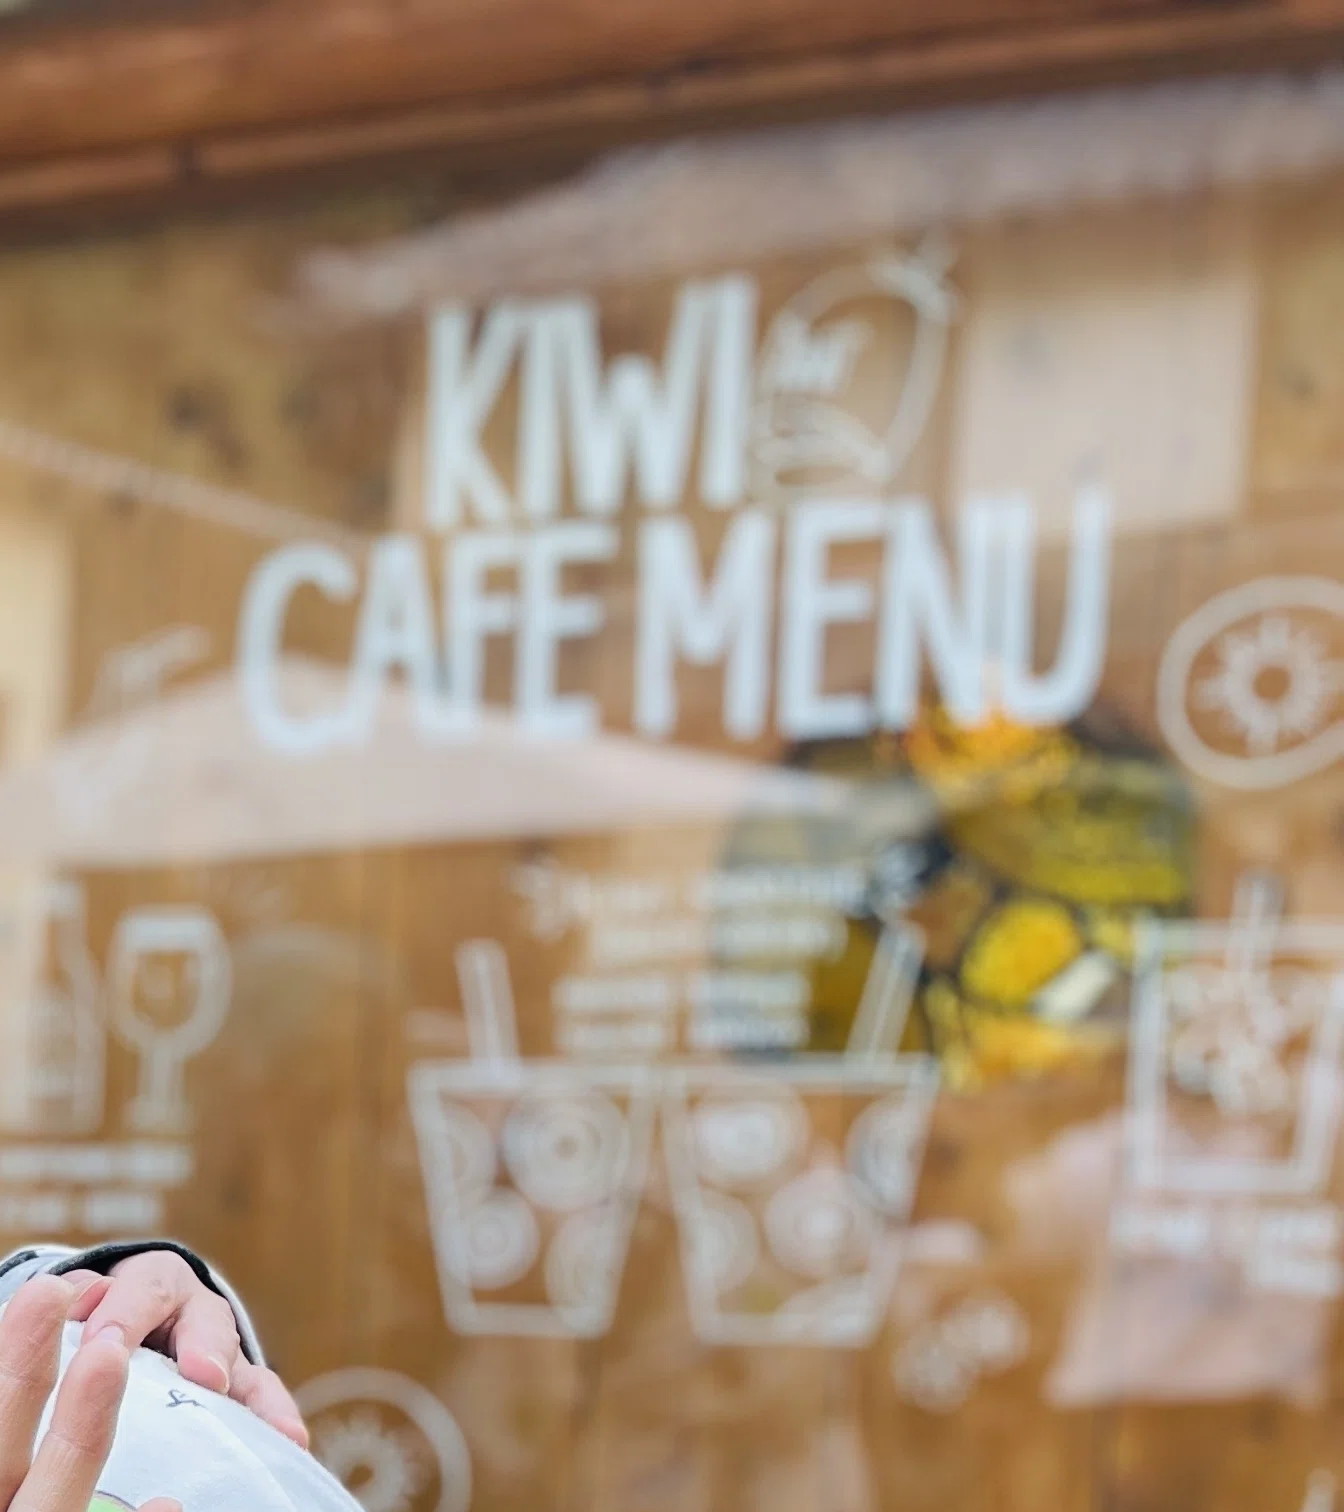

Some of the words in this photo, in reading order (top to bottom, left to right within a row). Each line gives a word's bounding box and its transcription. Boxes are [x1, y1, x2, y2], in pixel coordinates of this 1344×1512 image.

[424, 272, 757, 530] KIWI
[234, 521, 622, 755] CAFE
[631, 482, 1112, 740] MENU
